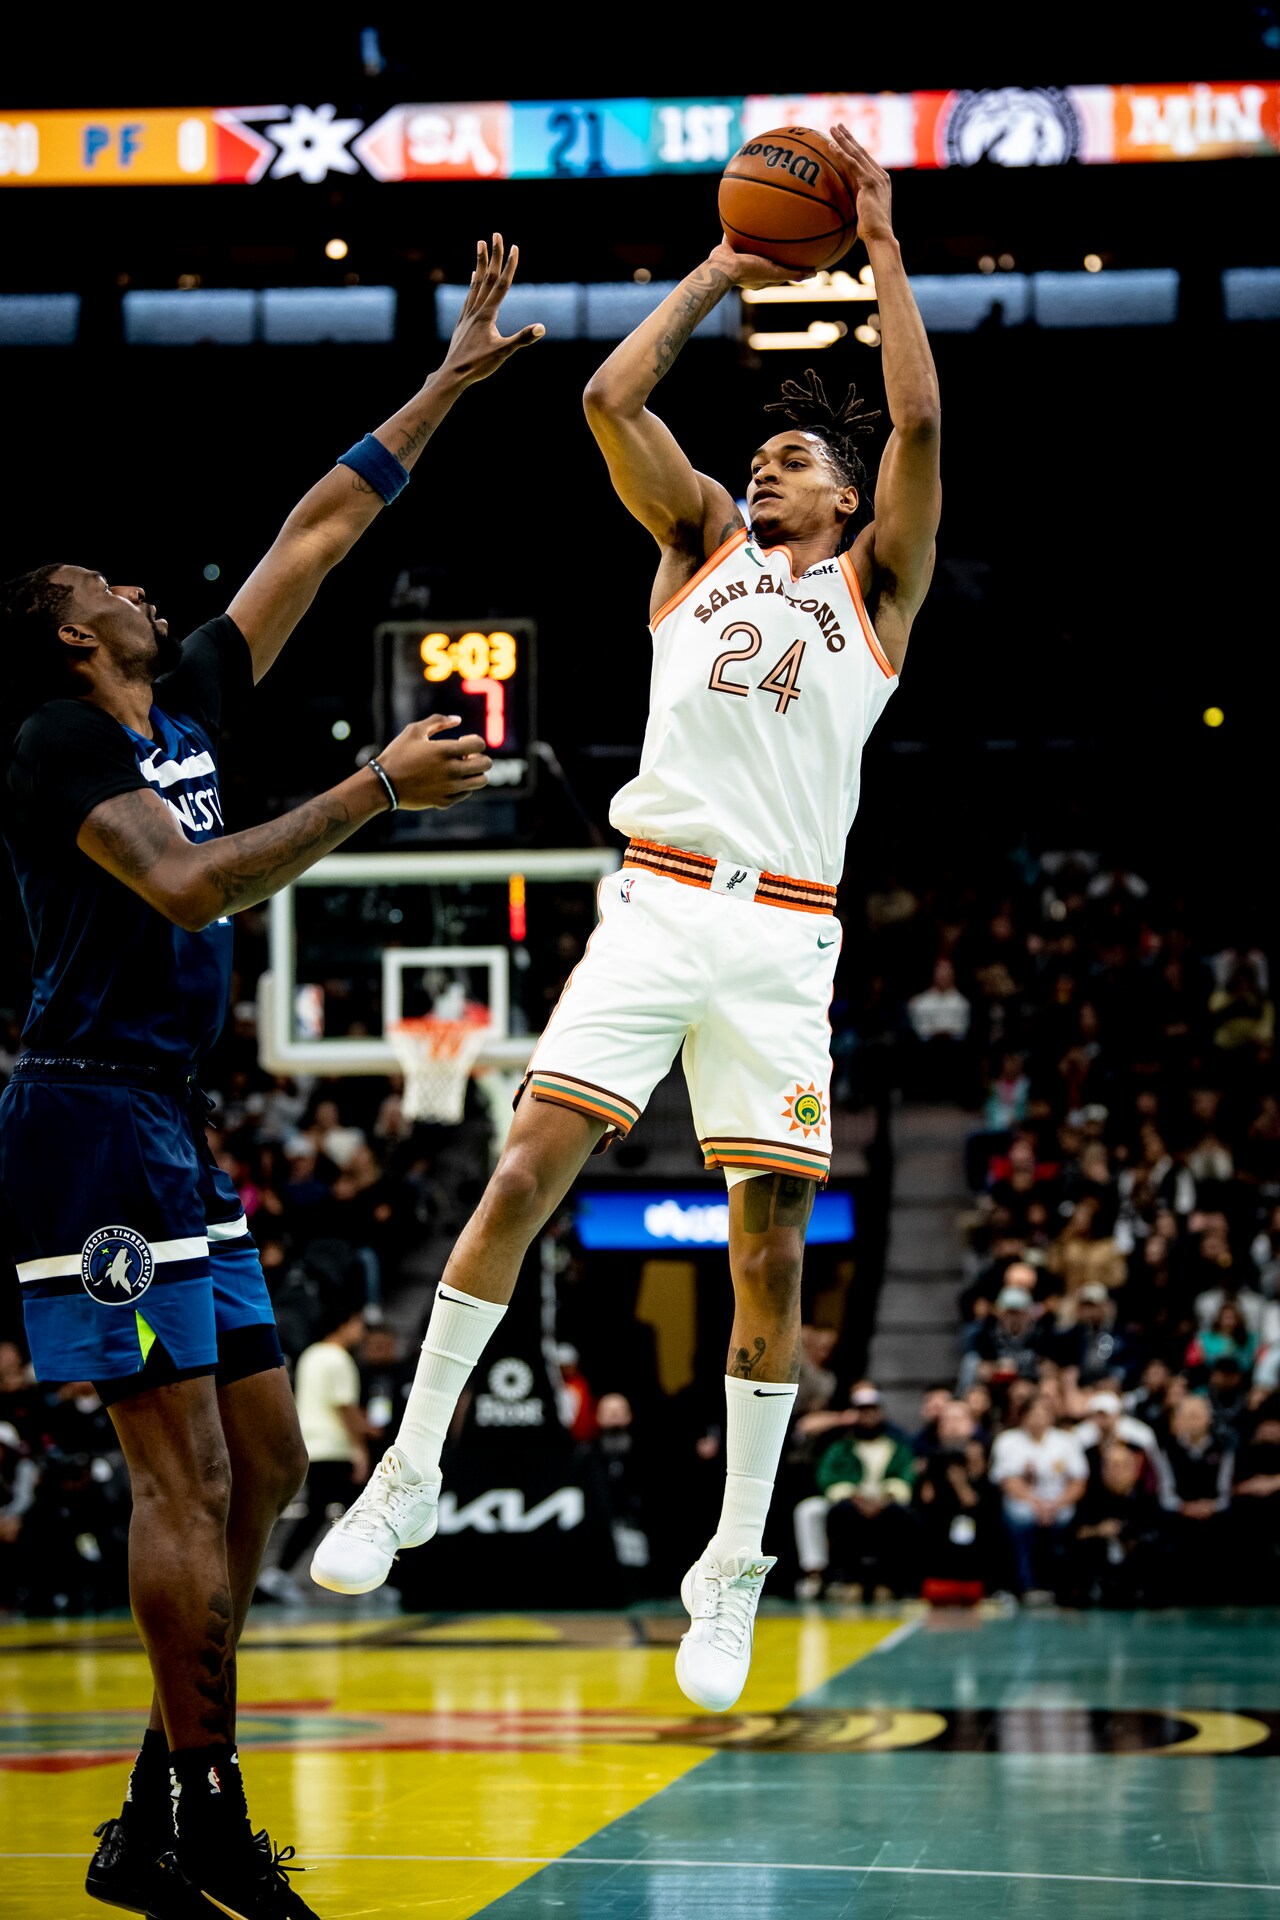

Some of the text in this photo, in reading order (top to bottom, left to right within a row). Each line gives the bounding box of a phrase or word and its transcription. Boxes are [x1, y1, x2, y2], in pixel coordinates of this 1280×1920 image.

[82, 124, 146, 171] PF
[547, 110, 605, 175] 21
[1131, 86, 1267, 155] MIN
[738, 143, 821, 188] Wilson
[693, 580, 749, 625] SAN
[420, 631, 517, 682] 5:03
[707, 621, 807, 715] 24
[460, 677, 505, 749] 7
[83, 1229, 151, 1289] MINNESOTA TIMBERWOLVES
